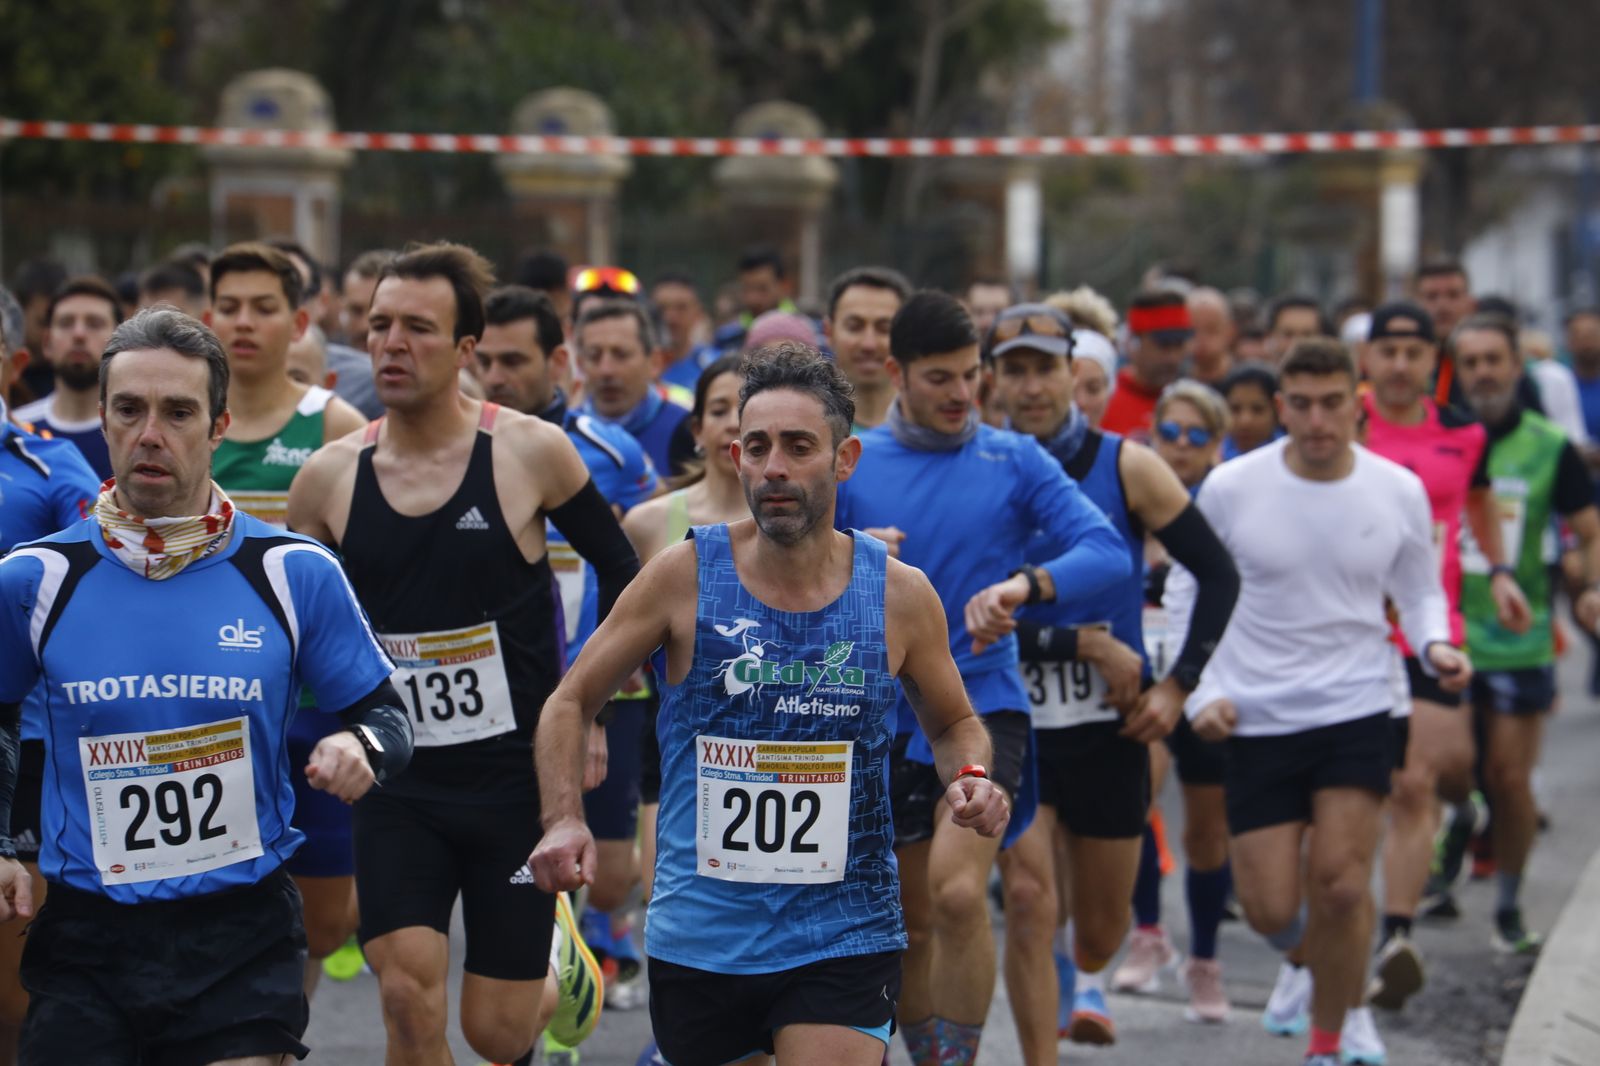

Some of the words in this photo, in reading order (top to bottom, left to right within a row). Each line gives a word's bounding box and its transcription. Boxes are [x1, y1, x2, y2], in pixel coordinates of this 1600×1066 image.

[62, 674, 263, 704] TROTASIERRA
[404, 668, 484, 723] 133
[1024, 661, 1092, 706] 319
[774, 695, 861, 716] Atletismo
[88, 738, 147, 766] XXXIX
[186, 735, 218, 747] TRINIDAD
[703, 741, 756, 768] XXXIX
[89, 770, 116, 781] Colegio
[138, 764, 168, 776] Trinidad
[176, 749, 244, 771] TRINITARIOS
[701, 767, 723, 779] Colegio
[744, 772, 774, 782] Trinidad
[781, 773, 845, 783] TRINITARIOS
[120, 773, 227, 851] 292
[722, 788, 821, 853] 202
